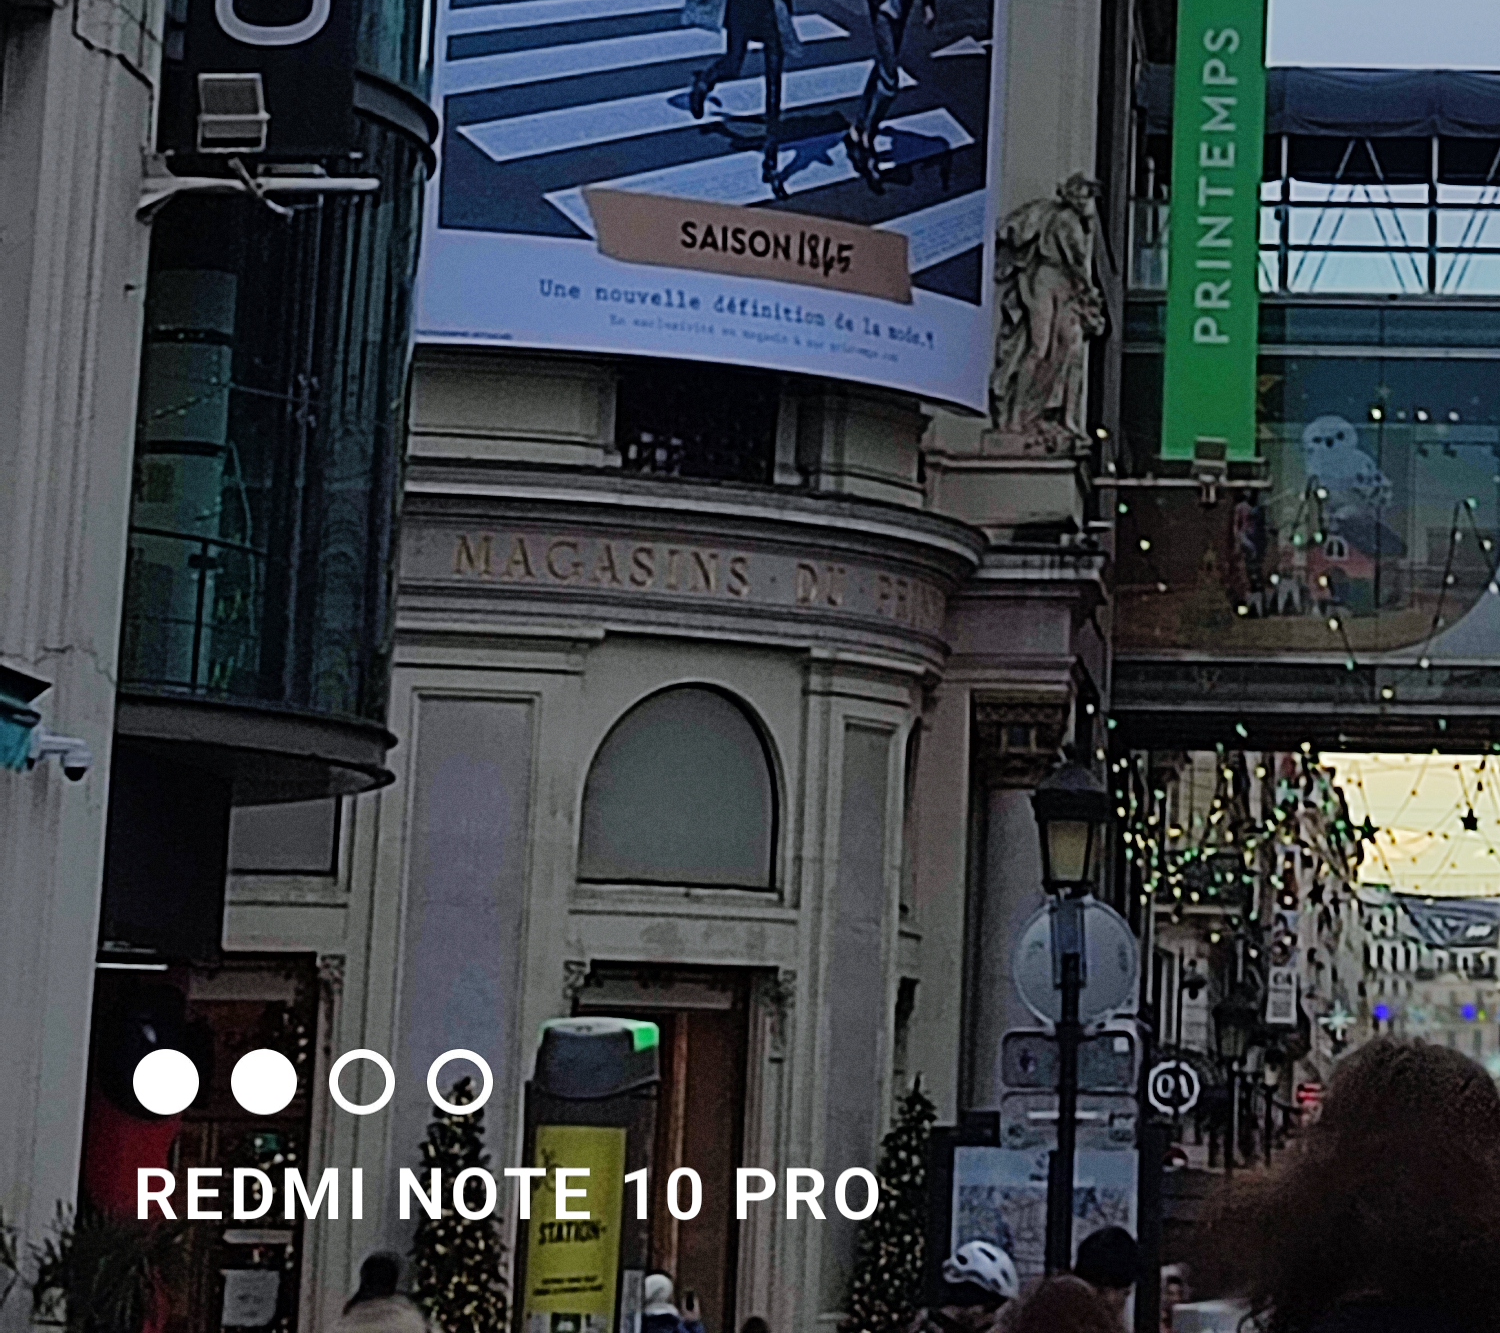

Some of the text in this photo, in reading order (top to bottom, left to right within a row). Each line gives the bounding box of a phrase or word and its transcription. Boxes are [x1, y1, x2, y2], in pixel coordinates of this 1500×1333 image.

[1193, 26, 1241, 347] PRINTEMPS
[680, 220, 792, 261] SAISON
[539, 278, 581, 299] Une
[595, 286, 701, 311] nouvelle
[713, 295, 825, 328] définition
[453, 533, 749, 598] MAGASINS
